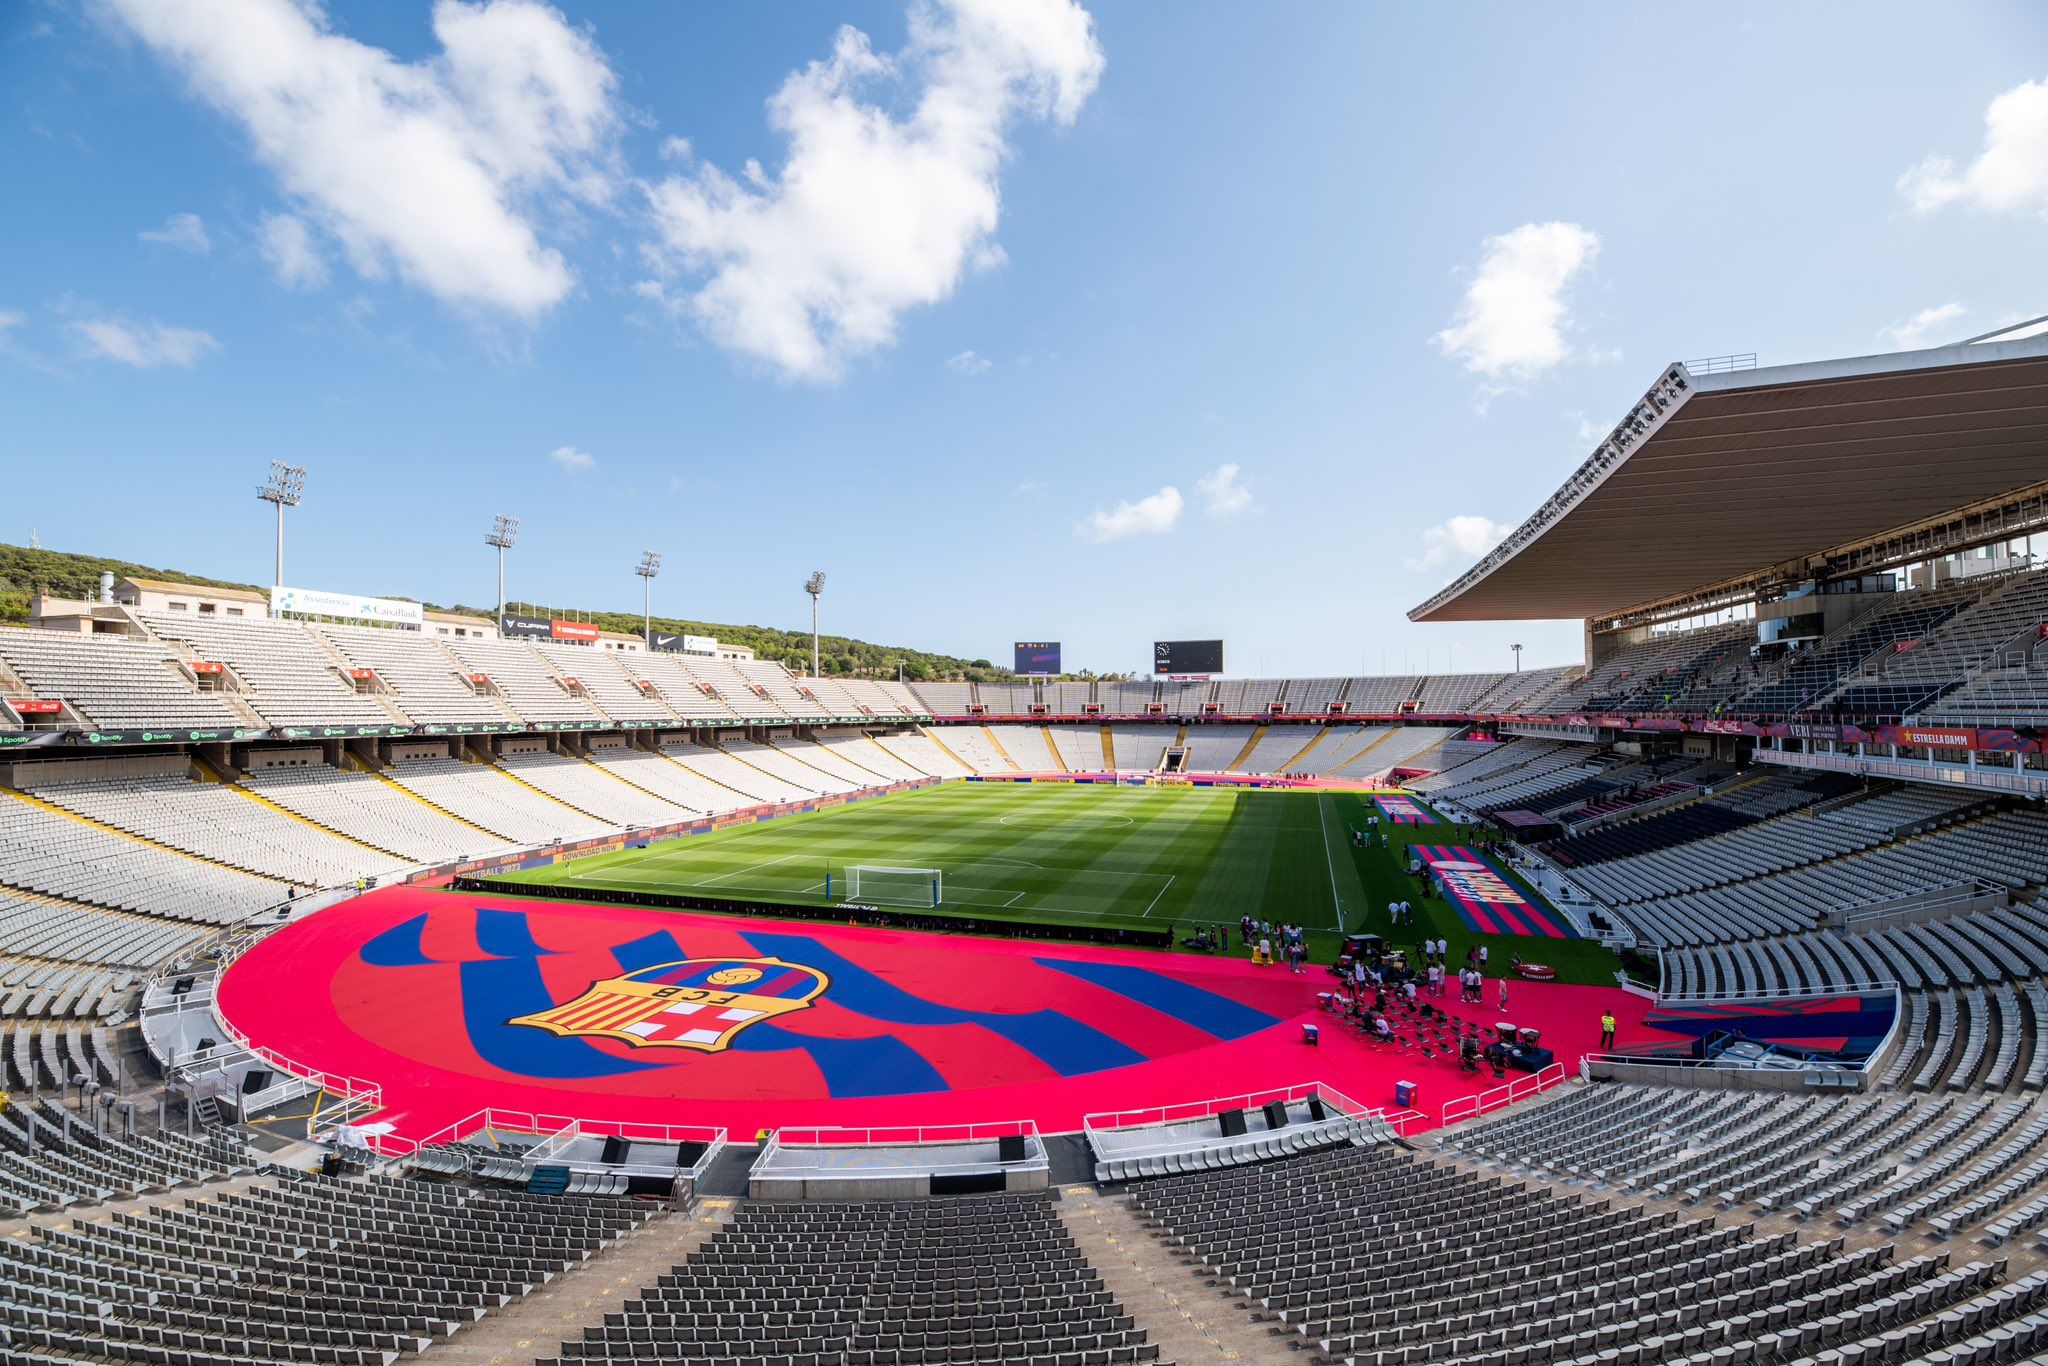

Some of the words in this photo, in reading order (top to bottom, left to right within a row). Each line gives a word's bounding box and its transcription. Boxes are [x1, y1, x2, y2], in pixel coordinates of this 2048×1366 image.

[374, 605, 418, 619] CaixaBank
[517, 622, 550, 631] CUPRA
[1790, 724, 1810, 737] VERI
[1913, 733, 1945, 744] ESTRELLA
[1945, 735, 1968, 746] DAMM
[562, 847, 600, 861] DOWNLOAD
[602, 844, 617, 853] NOW
[502, 863, 521, 874] 2023
[652, 987, 741, 1005] FCB
